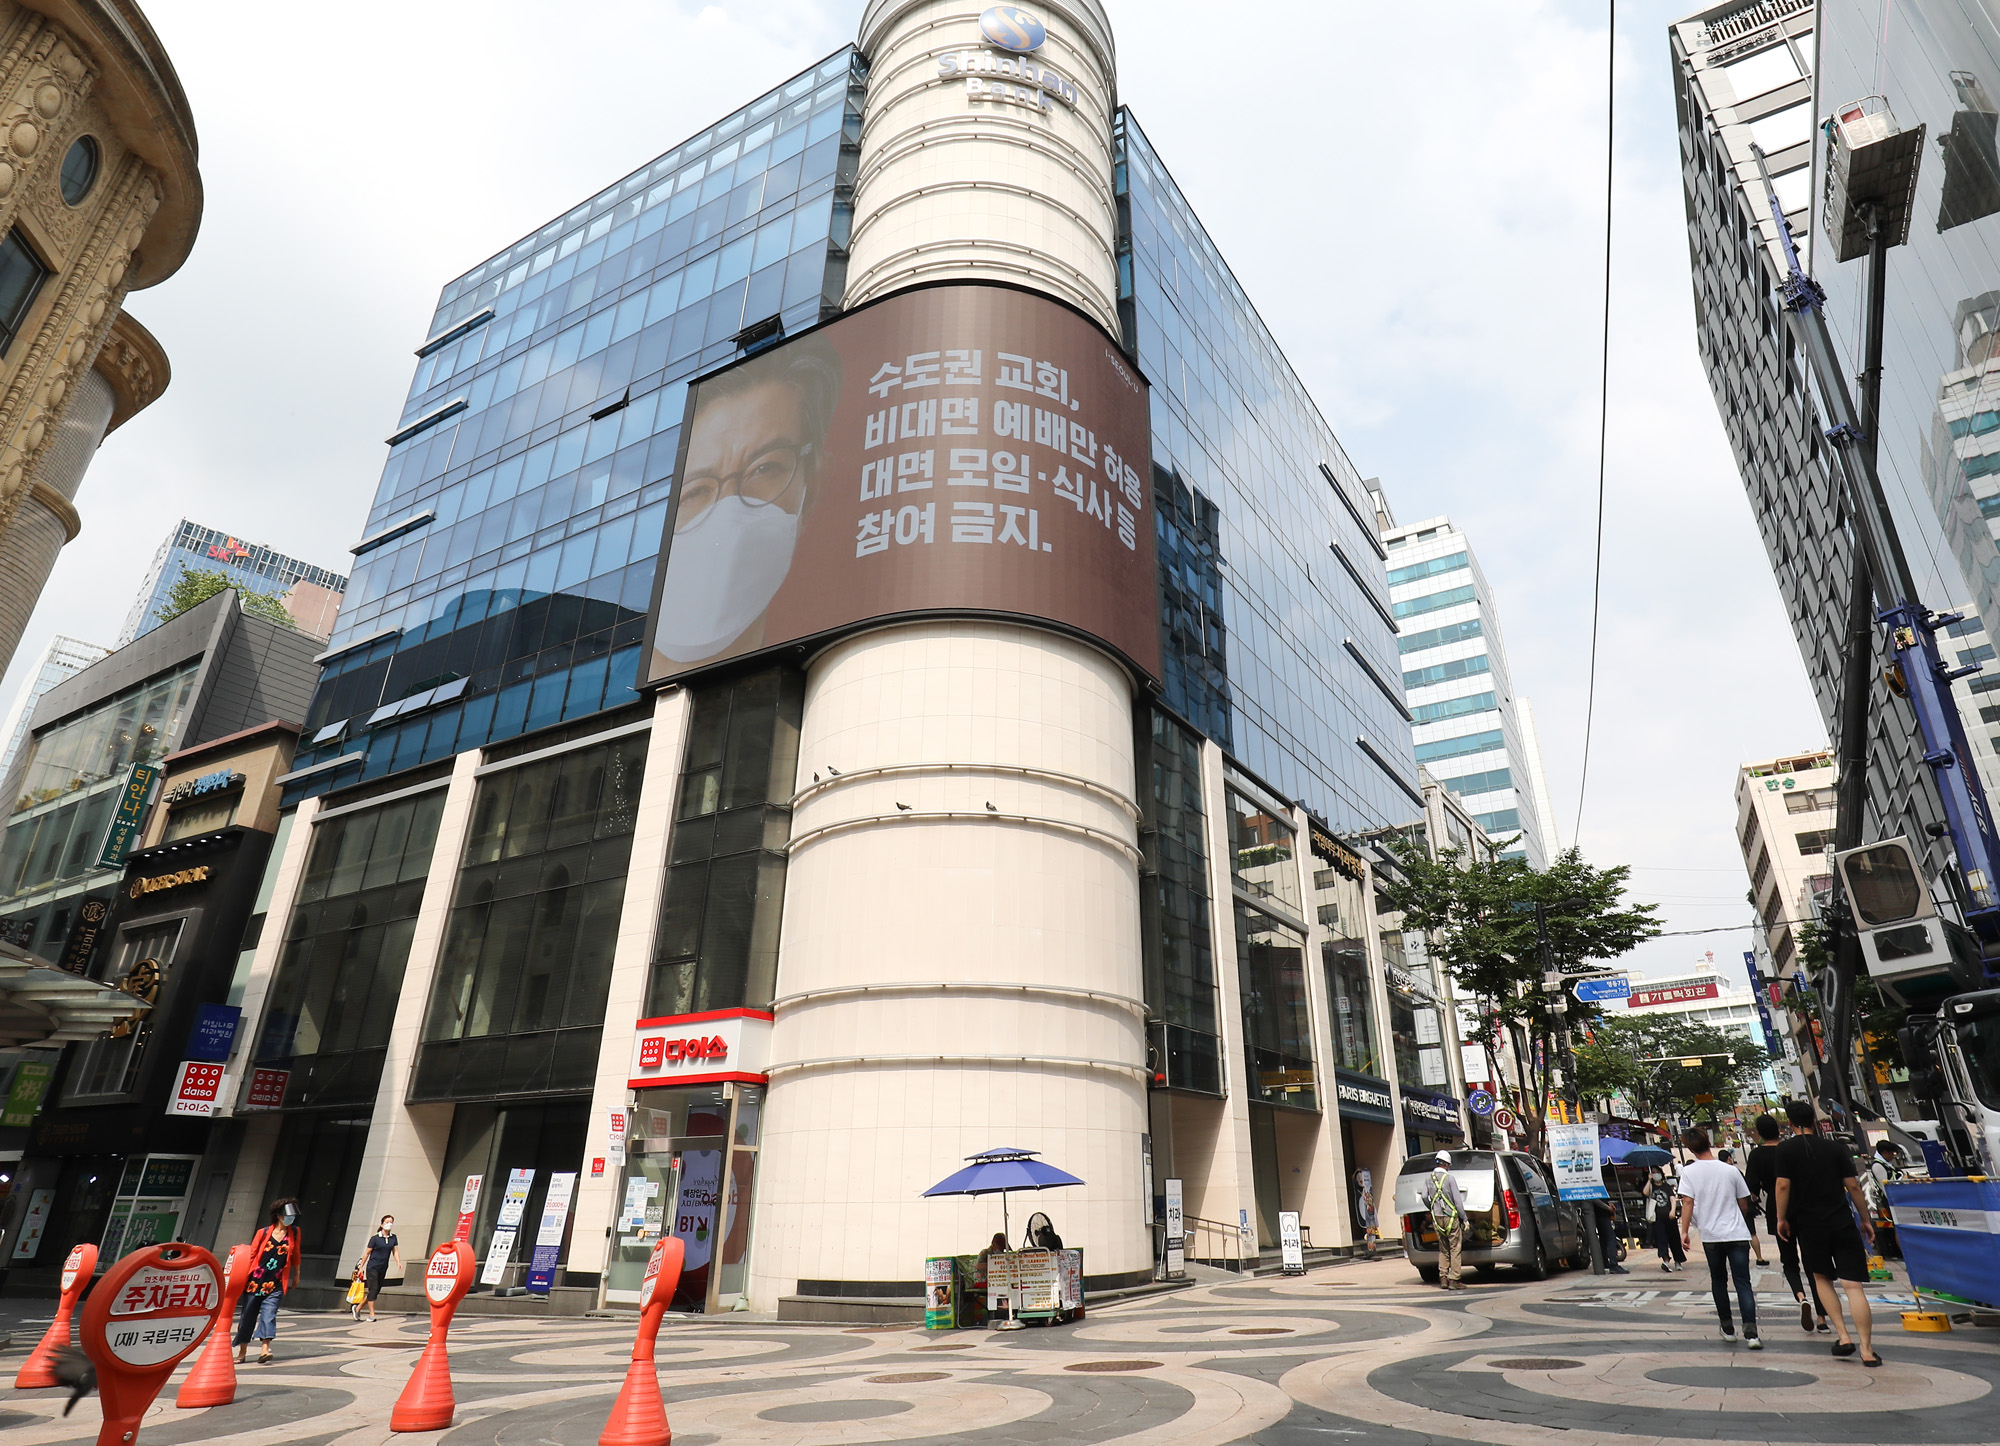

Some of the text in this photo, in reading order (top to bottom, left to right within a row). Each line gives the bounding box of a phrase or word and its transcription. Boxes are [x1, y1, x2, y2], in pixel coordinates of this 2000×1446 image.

[938, 50, 1078, 106] Shinhan
[966, 77, 1053, 111] Bank
[869, 349, 1080, 412] 수도권 교회,
[864, 397, 1142, 510] 비대면 예배만 허용
[860, 449, 934, 502] 대면
[1117, 501, 1136, 551] 등
[855, 501, 1052, 558] 참여 금지.
[207, 545, 232, 562] SK
[124, 769, 152, 816] 티안나
[167, 781, 193, 802] 티안나
[109, 827, 128, 861] 성형외과
[144, 866, 208, 893] TIGER SUGAR
[79, 928, 96, 954] TIGER
[641, 1055, 657, 1064] daiso
[665, 1034, 728, 1061] 다이소
[183, 1086, 212, 1097] daiso
[1338, 1085, 1391, 1108] PARIS BAGUETTE
[176, 1102, 210, 1113] 다이소
[680, 1216, 694, 1233] B1
[1168, 1207, 1180, 1222] 치과
[1941, 1212, 1958, 1227] 제일
[1283, 1239, 1299, 1249] 치과
[431, 1262, 456, 1274] 주차금지
[123, 1282, 211, 1311] 주차금지
[114, 1327, 195, 1347] (재) 국립극단
